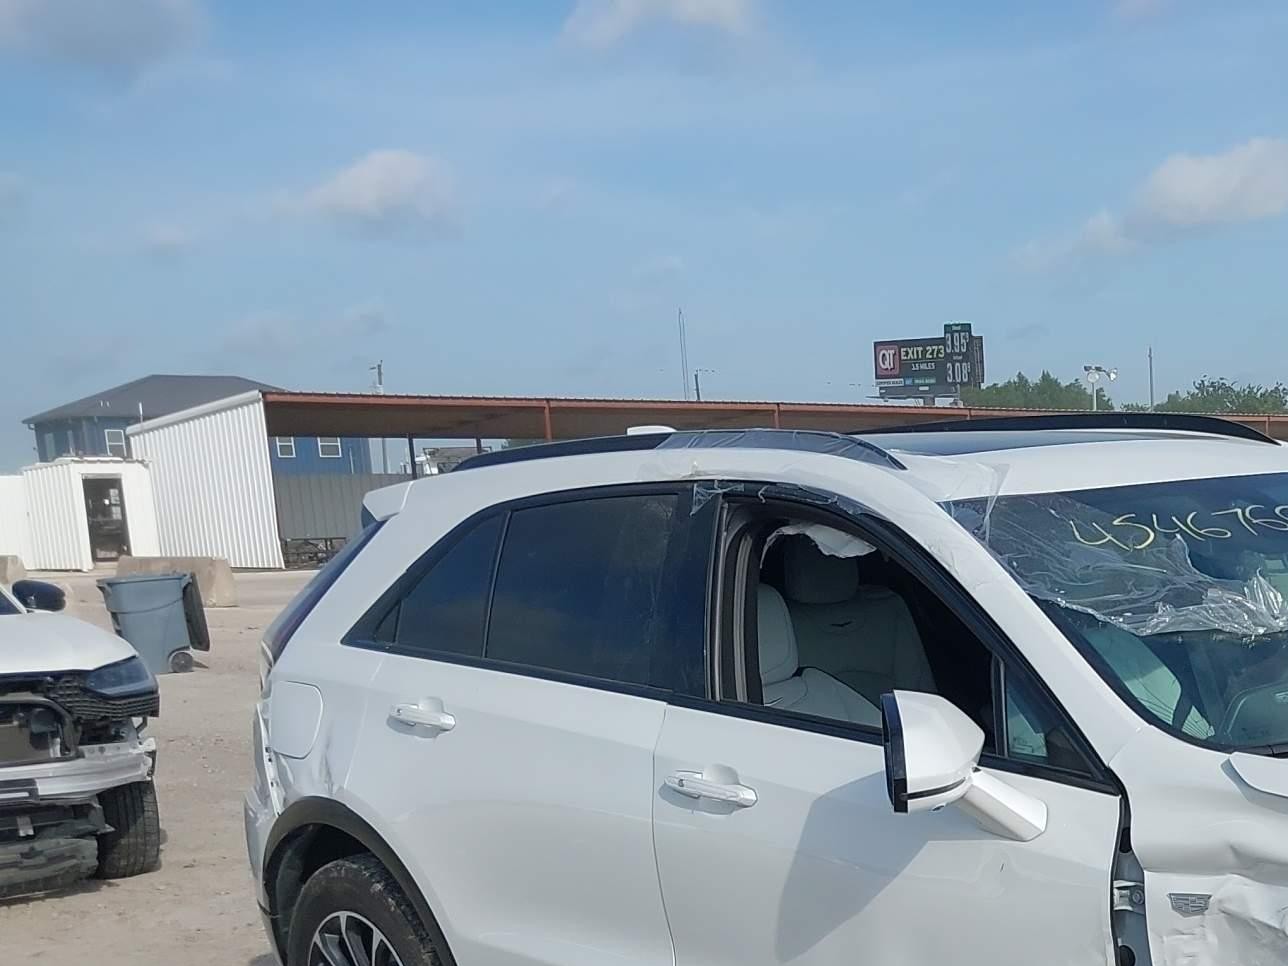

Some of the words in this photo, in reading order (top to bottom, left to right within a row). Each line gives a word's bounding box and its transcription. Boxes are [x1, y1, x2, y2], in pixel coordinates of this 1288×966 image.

[879, 350, 896, 370] QT
[900, 347, 923, 360] EXIT
[925, 345, 945, 359] 273
